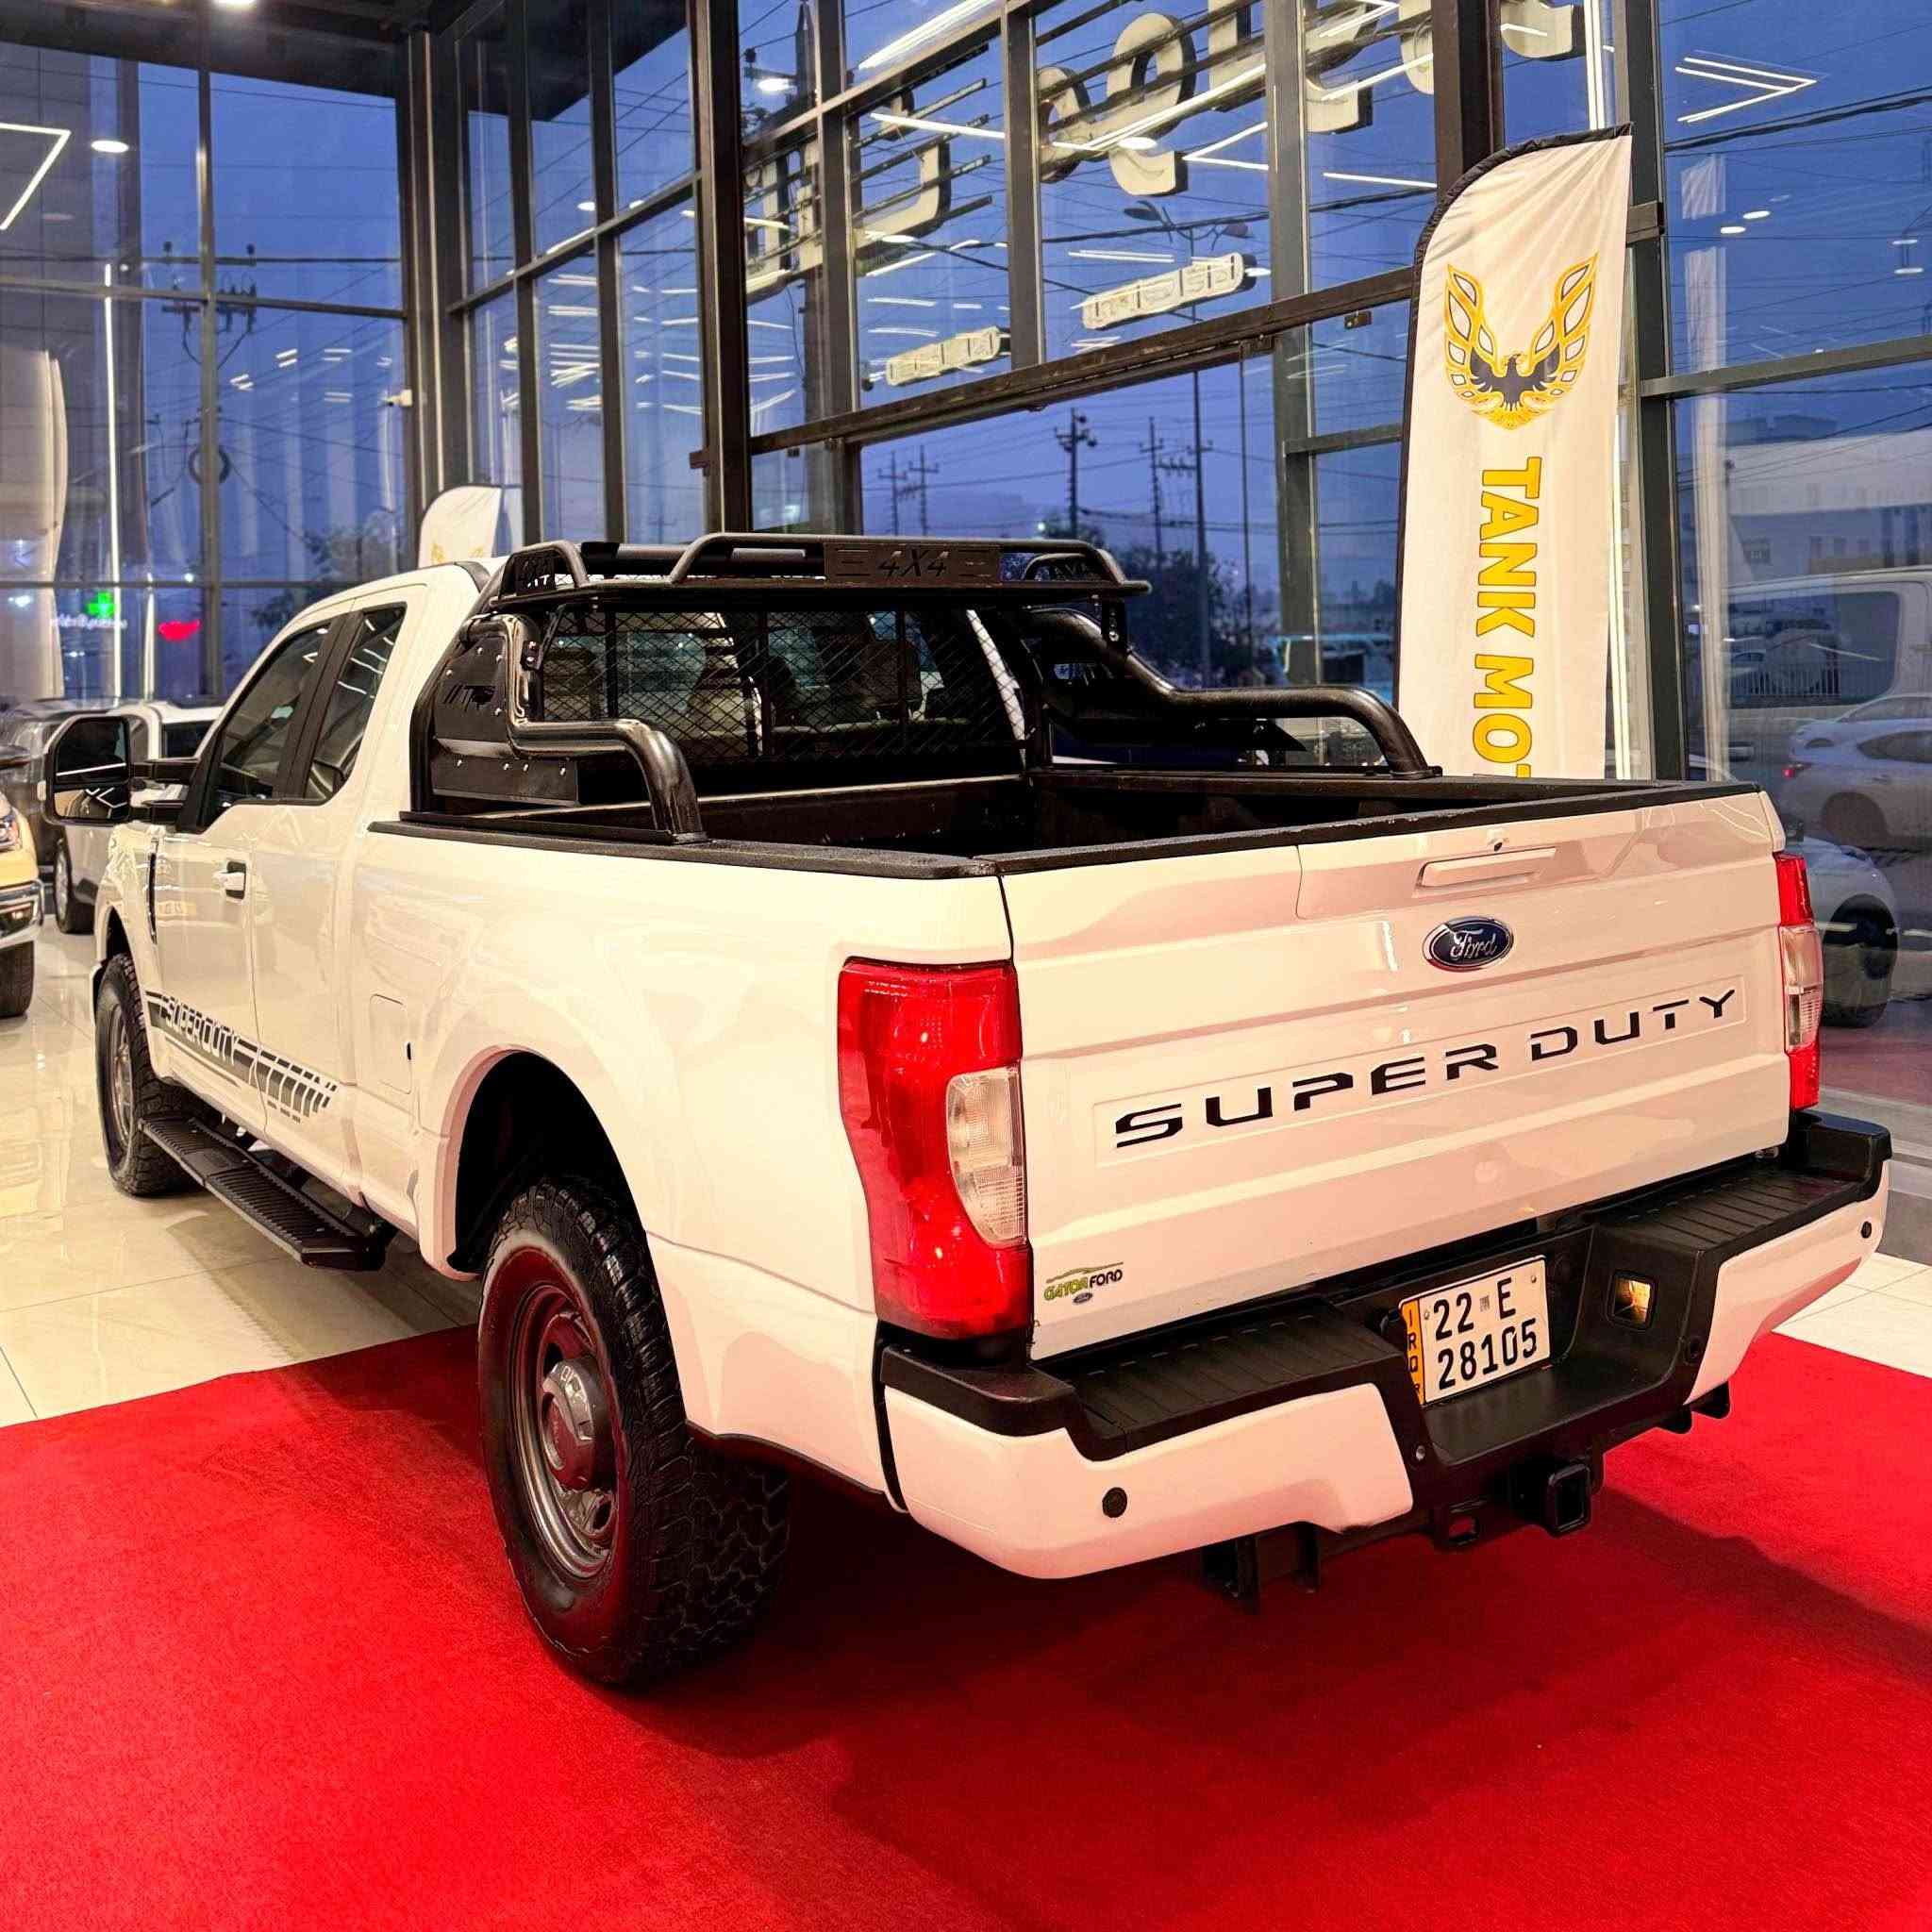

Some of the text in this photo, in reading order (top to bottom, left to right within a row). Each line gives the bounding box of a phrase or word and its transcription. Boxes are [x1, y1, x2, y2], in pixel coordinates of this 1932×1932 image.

[879, 548, 951, 577] 4X4
[1473, 457, 1542, 779] TANK MO
[1449, 928, 1498, 960] Ford
[1114, 989, 1736, 1148] SUPER DUTY
[1090, 1269, 1123, 1288] FORD
[1433, 1276, 1516, 1341] 22 E
[1438, 1317, 1538, 1390] 28105
